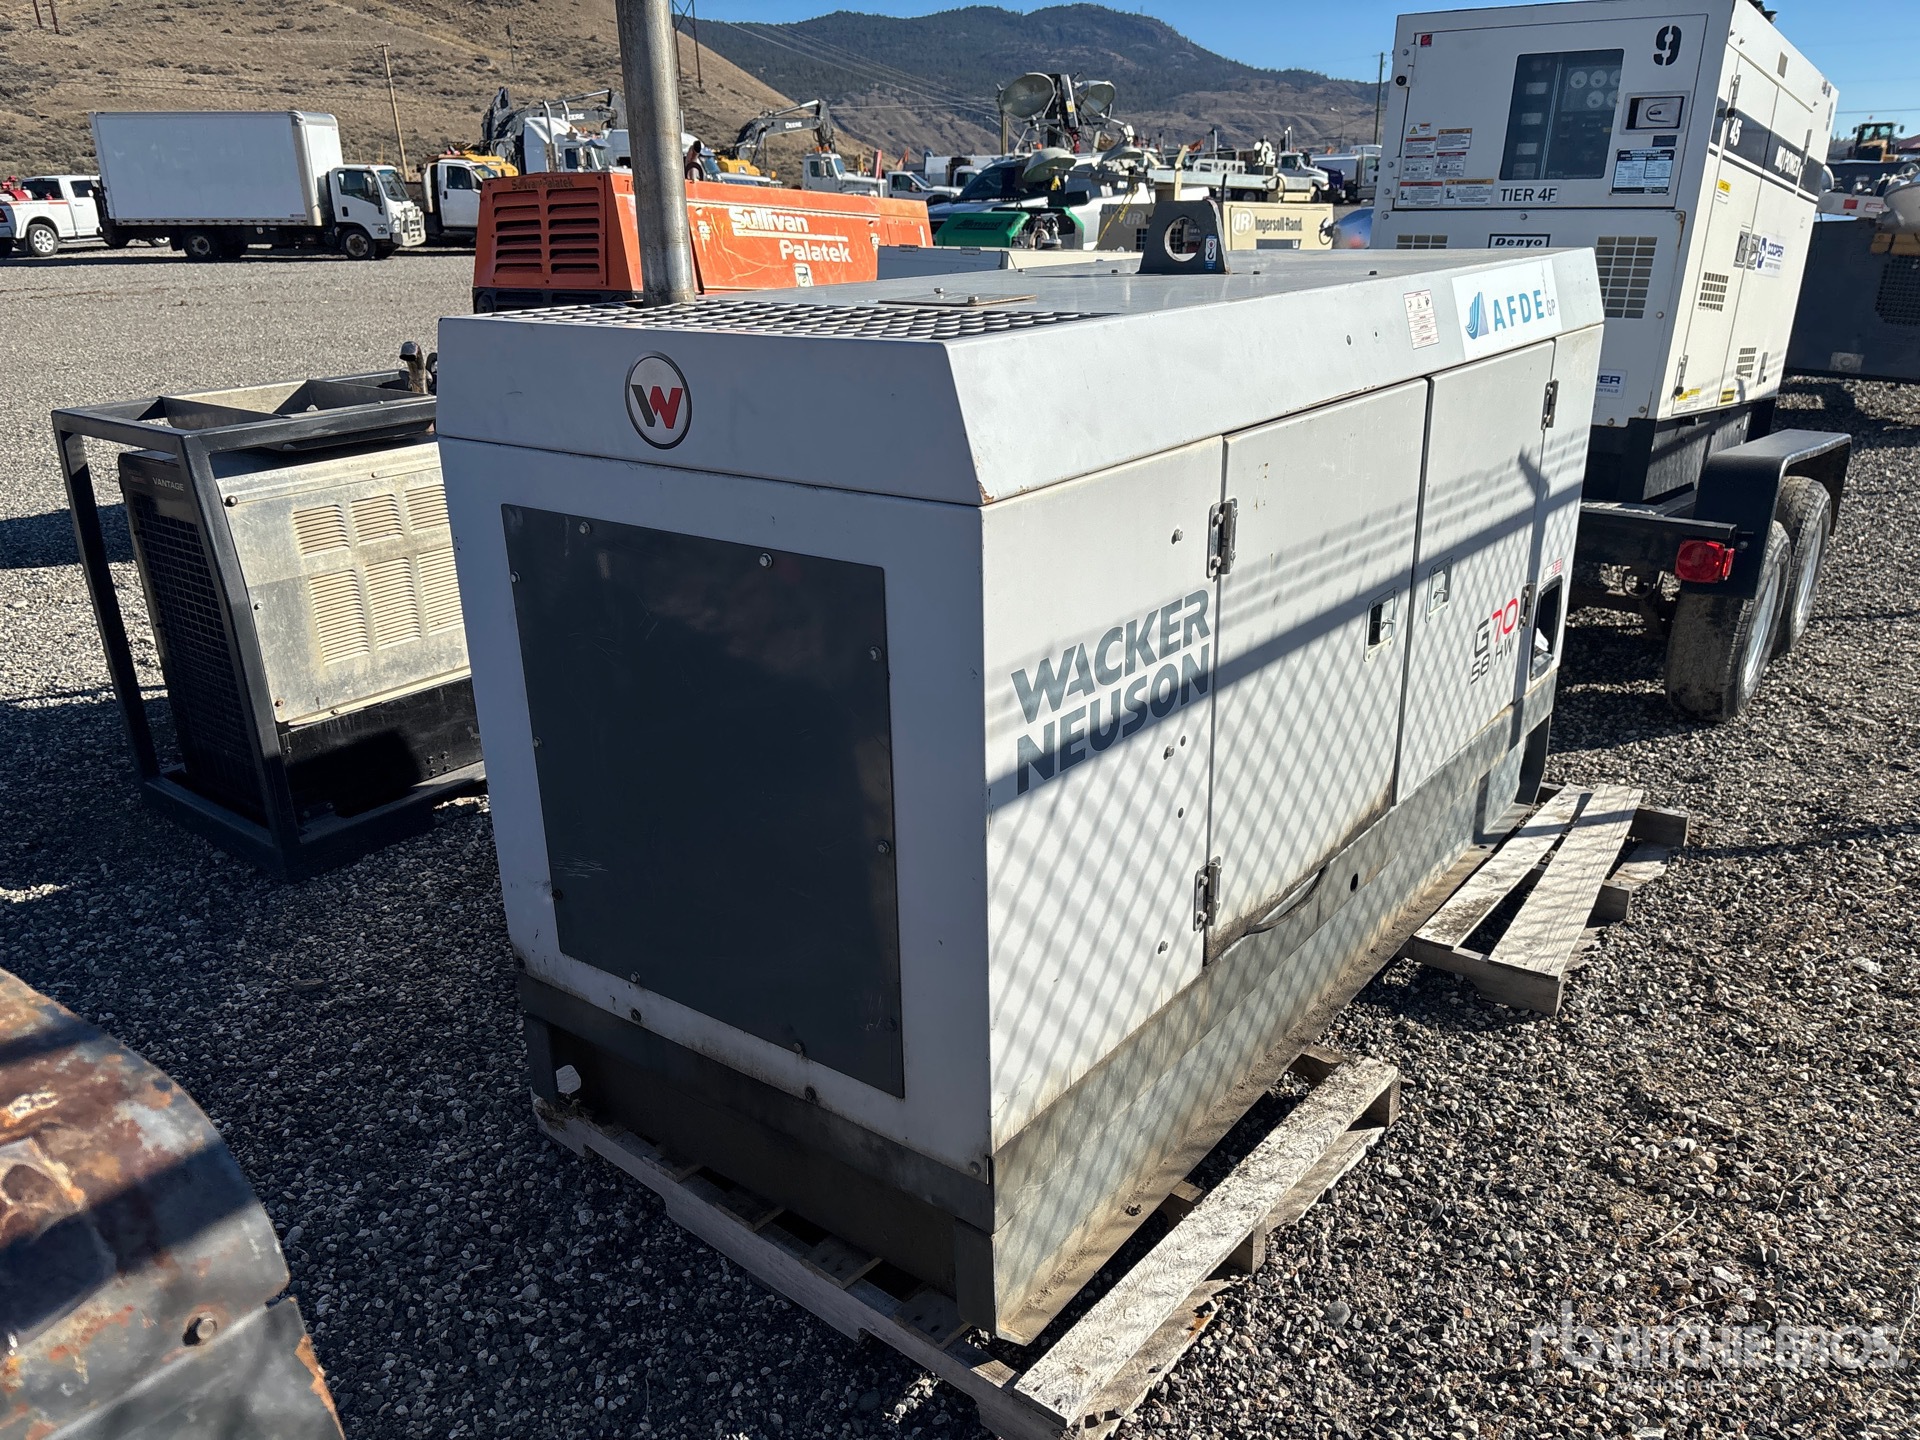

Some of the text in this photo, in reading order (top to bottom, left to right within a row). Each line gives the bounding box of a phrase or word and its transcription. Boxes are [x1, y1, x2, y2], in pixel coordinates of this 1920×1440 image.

[1653, 25, 1682, 66] 9
[785, 121, 803, 129] DEERE
[1729, 117, 1743, 147] 45
[1501, 188, 1534, 202] TIER
[1537, 188, 1557, 202] 4F
[728, 207, 809, 233] Sullivan
[779, 239, 853, 262] Palatek
[1494, 238, 1543, 248] Denyo
[1494, 289, 1556, 332] AFDE GP
[152, 476, 185, 492] VANTAGE
[1010, 589, 1210, 724] WACKER
[1470, 653, 1490, 685] 58
[1016, 644, 1211, 796] NEUSON
